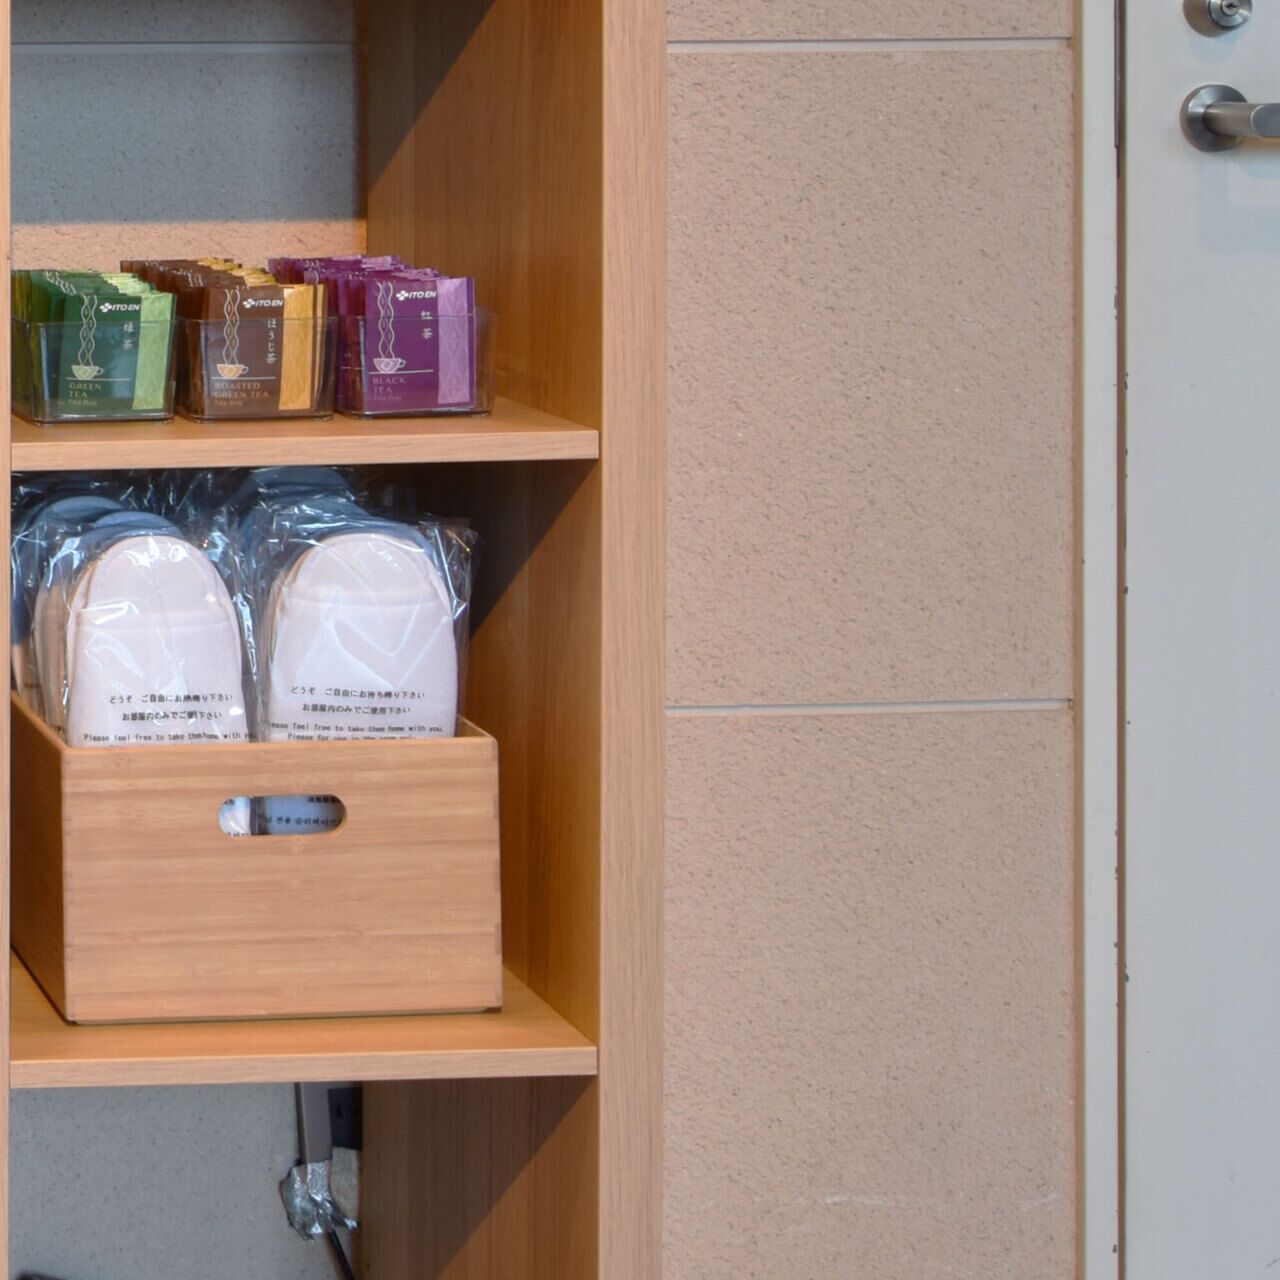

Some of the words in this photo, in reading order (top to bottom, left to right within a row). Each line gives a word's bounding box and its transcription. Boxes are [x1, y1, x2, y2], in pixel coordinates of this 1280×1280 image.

[408, 291, 424, 299] ITO
[424, 290, 437, 298] EN
[112, 304, 128, 312] ITO
[128, 303, 141, 311] EN
[270, 299, 284, 307] EN
[266, 318, 277, 365] ほうじ茶
[372, 376, 406, 385] BLACK
[68, 382, 102, 390] GREEN
[213, 382, 260, 390] ROASTED
[69, 390, 88, 398] TEA
[213, 390, 247, 399] GREEN
[251, 390, 269, 398] TEA
[291, 686, 316, 696] どうぞ
[325, 688, 425, 699] ご自由にお持ち帰り下さい
[110, 694, 133, 704] どうぞ
[293, 721, 309, 730] feel
[314, 722, 331, 731] free
[335, 724, 344, 732] to
[84, 732, 110, 742] Please
[135, 732, 152, 741] free
[156, 733, 165, 741] to
[168, 733, 185, 742] take
